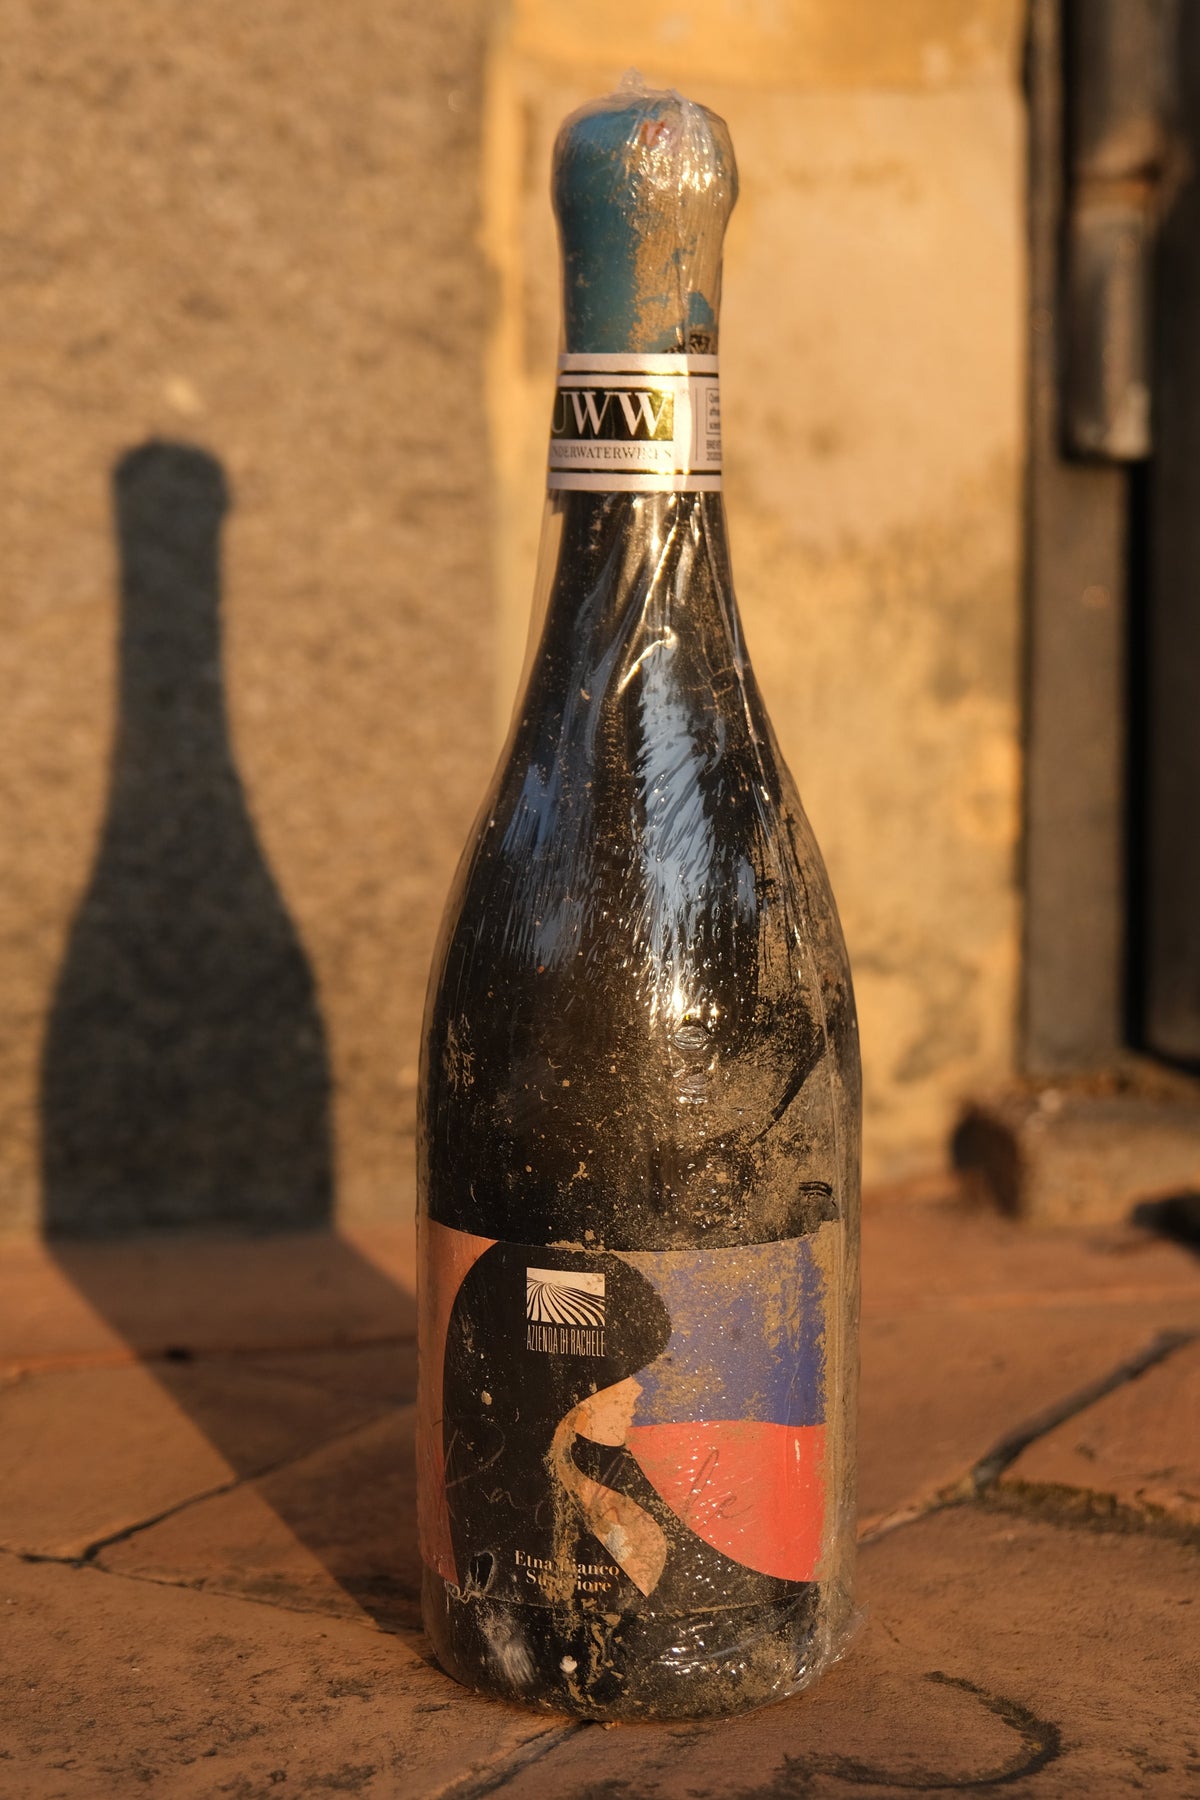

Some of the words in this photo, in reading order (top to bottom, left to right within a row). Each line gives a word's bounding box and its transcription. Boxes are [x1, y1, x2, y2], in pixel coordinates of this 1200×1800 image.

[526, 1324, 558, 1354] AZIENDA
[570, 1329, 605, 1357] RACHELE
[514, 1550, 553, 1571] Etna
[525, 1568, 612, 1592] Suiore
